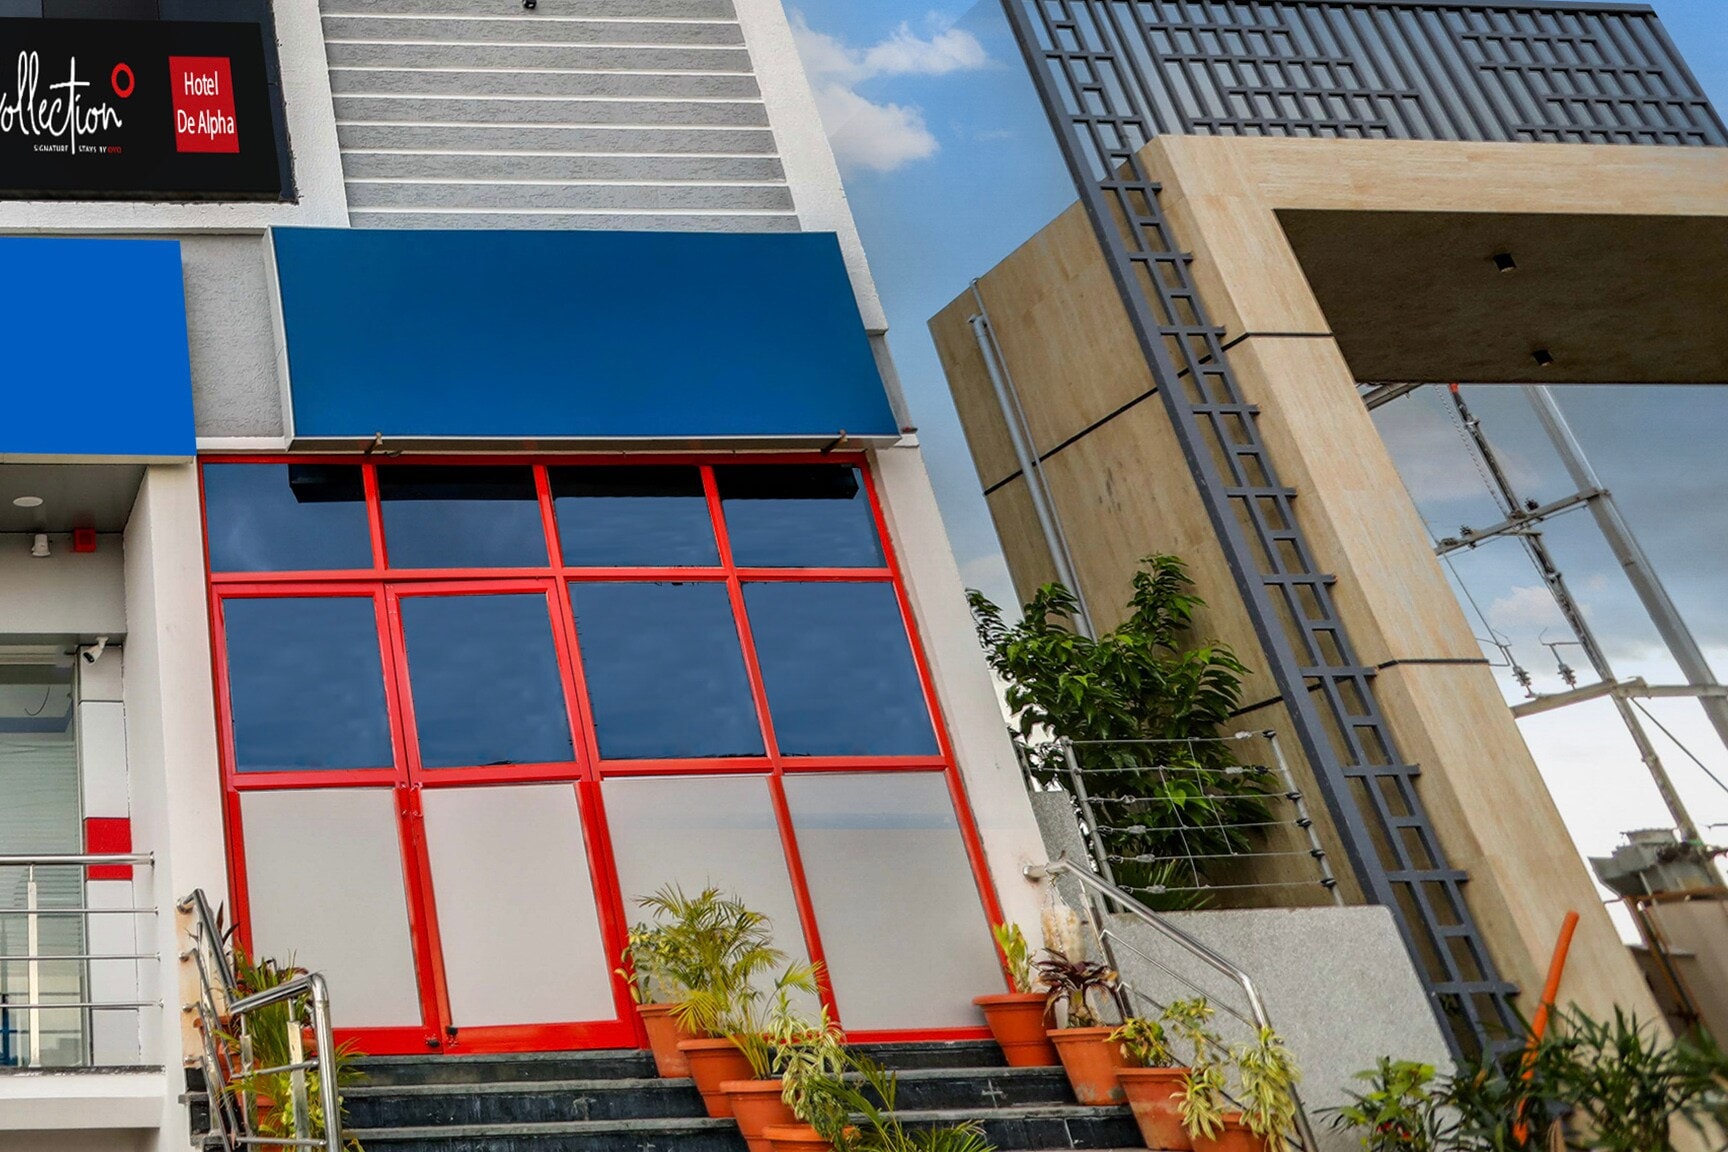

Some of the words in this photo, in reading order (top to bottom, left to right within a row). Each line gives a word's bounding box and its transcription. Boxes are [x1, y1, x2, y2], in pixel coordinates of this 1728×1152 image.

[184, 70, 219, 96] Hotel
[177, 109, 195, 134] De
[197, 109, 235, 140] Alpha
